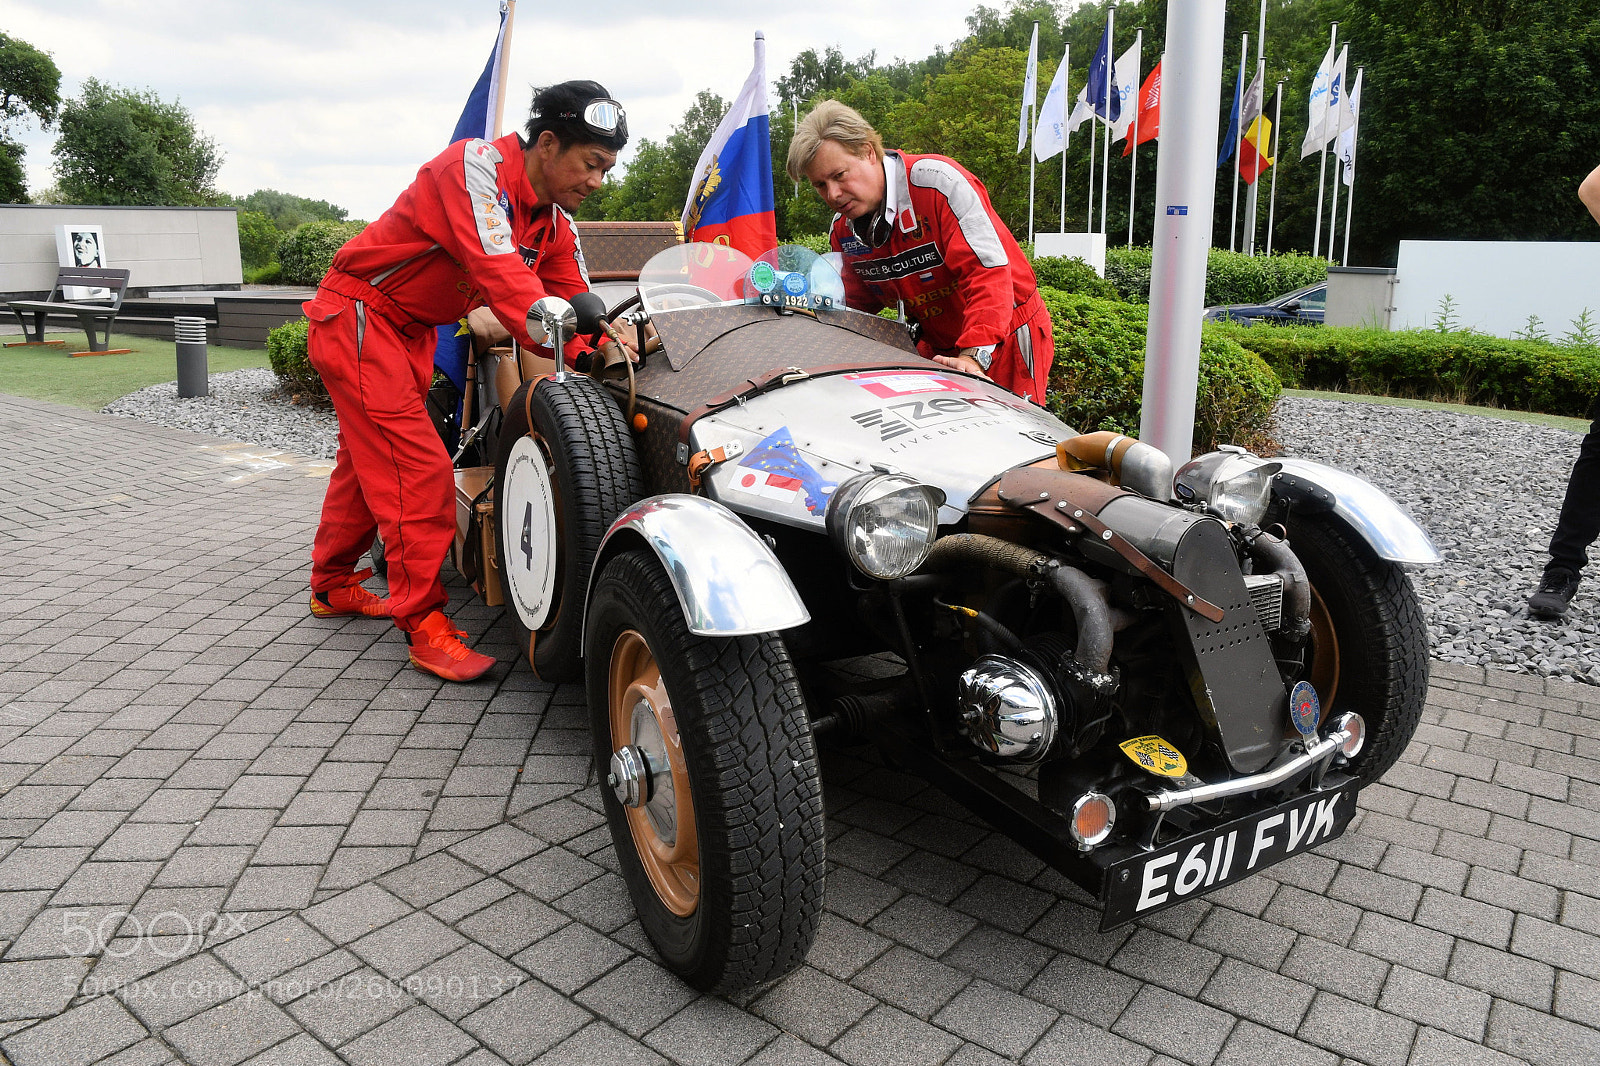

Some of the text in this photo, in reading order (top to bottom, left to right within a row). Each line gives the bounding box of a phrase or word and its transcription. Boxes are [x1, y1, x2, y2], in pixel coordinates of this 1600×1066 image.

[892, 251, 938, 273] CULTURE
[785, 295, 809, 307] 1922
[889, 433, 933, 454] LIVE
[520, 500, 533, 572] 4
[1135, 792, 1342, 912] E611 FVK
